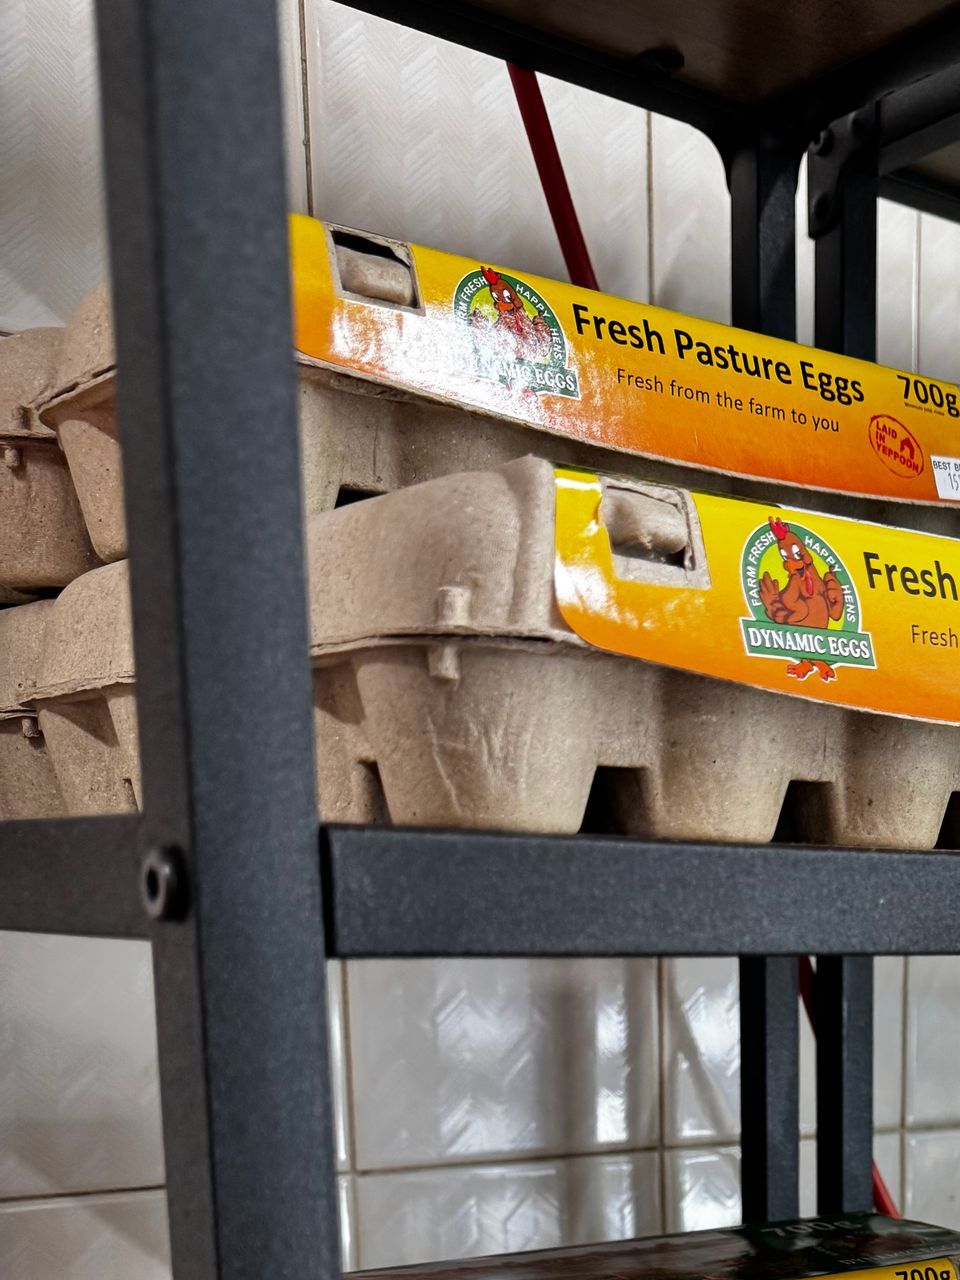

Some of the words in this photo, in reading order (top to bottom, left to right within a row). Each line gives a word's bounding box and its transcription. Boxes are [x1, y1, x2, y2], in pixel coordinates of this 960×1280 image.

[460, 275, 488, 299] FRESH
[515, 284, 551, 318] HAPPY
[550, 326, 564, 361] HENS
[572, 303, 666, 355] Fresh
[674, 328, 793, 385] Pasture
[799, 360, 865, 407] Eggs
[535, 368, 575, 391] EGGS
[896, 374, 960, 418] 700g
[617, 368, 664, 393] Fresh
[669, 380, 710, 404] from
[717, 391, 743, 411] the
[749, 398, 786, 421] farm
[792, 408, 807, 425] to
[812, 414, 839, 432] you
[876, 420, 898, 439] LAID
[876, 431, 886, 444] IN
[876, 443, 920, 473] YEPPOON
[933, 460, 951, 471] BEST
[749, 530, 776, 566] FRESH
[804, 535, 842, 573] HAPPY
[745, 570, 761, 607] FARM
[863, 551, 959, 601] Fresh
[841, 584, 856, 622] HENS
[748, 627, 826, 654] DYNAMIC
[827, 636, 870, 659] EGGS
[911, 624, 959, 650] Fresh
